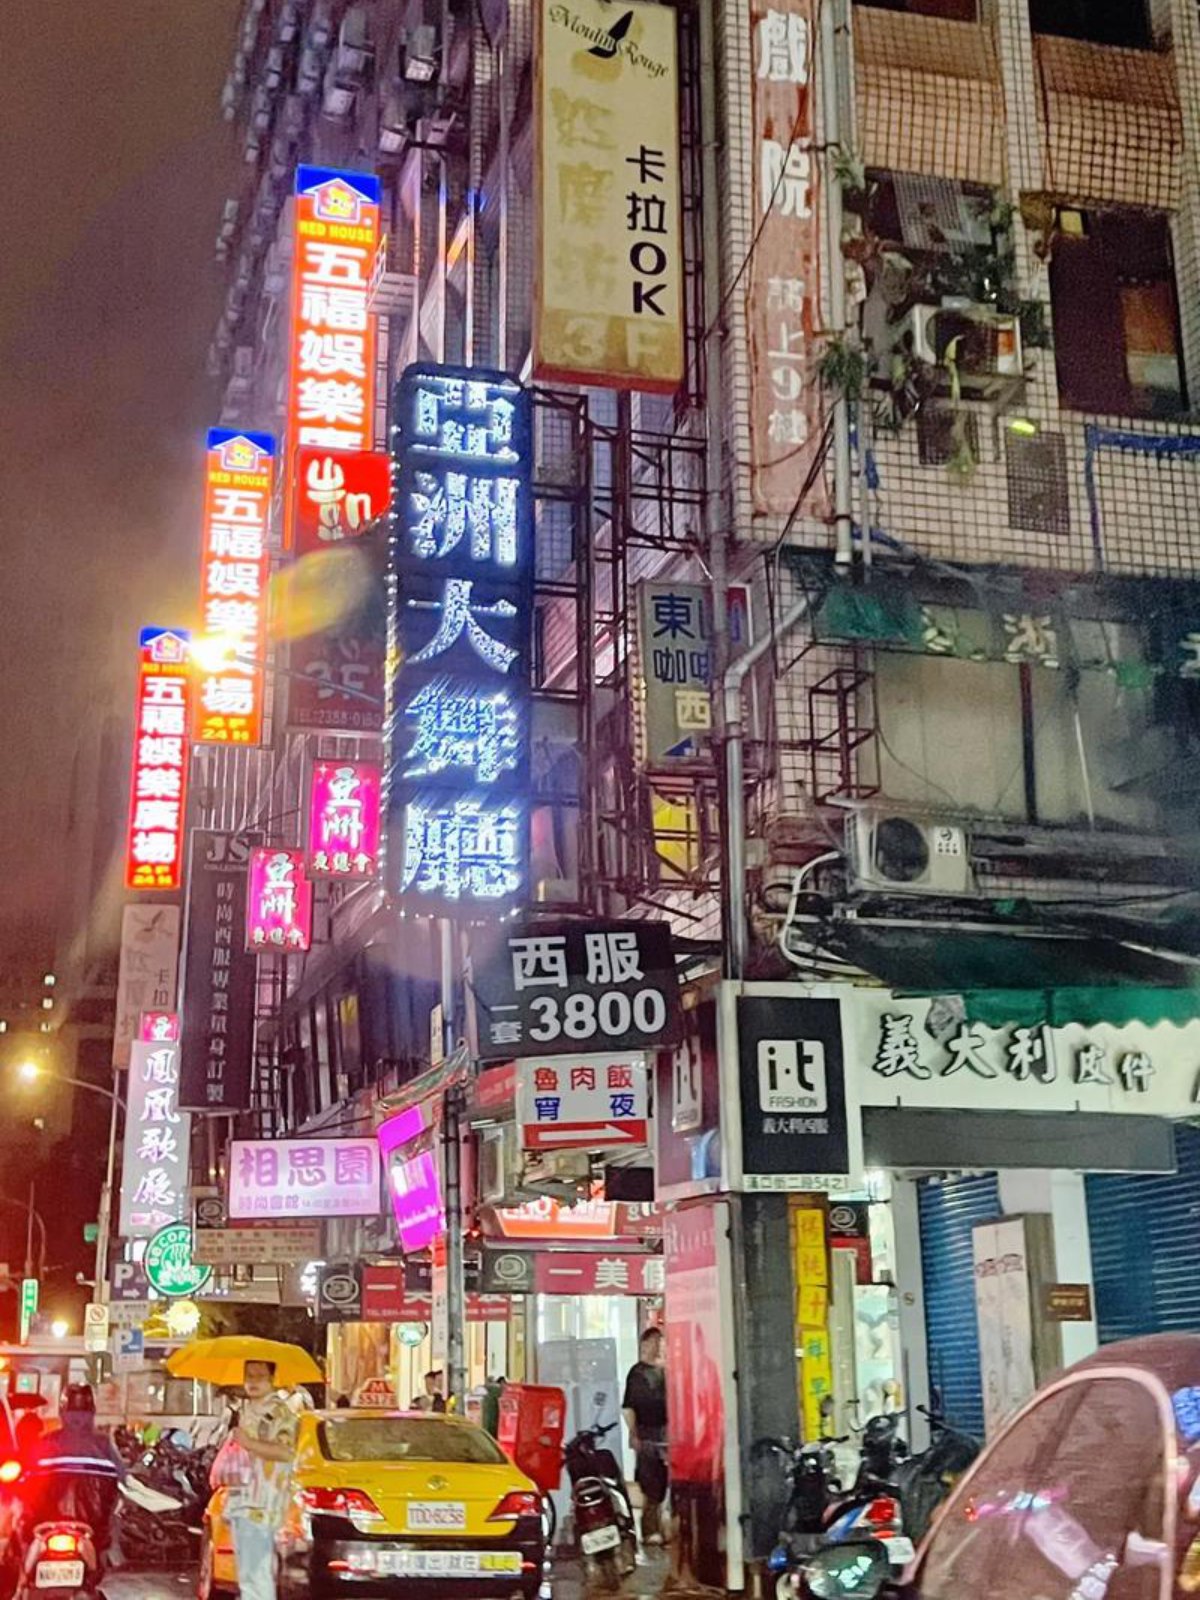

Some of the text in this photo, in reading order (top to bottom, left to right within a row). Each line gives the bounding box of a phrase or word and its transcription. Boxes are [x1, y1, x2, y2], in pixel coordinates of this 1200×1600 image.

[624, 41, 669, 78] Rouge
[298, 220, 374, 243] RED HOUSE
[625, 145, 668, 316] 卡拉OK
[400, 374, 521, 899] 亞洲大舞廳
[132, 676, 187, 863] 五福娛樂廣場
[508, 931, 646, 992] 西服
[529, 988, 667, 1043] 3800
[533, 1063, 635, 1093] 魯肉飯
[768, 1096, 818, 1108] FASHION
[238, 1146, 374, 1188] 相思園
